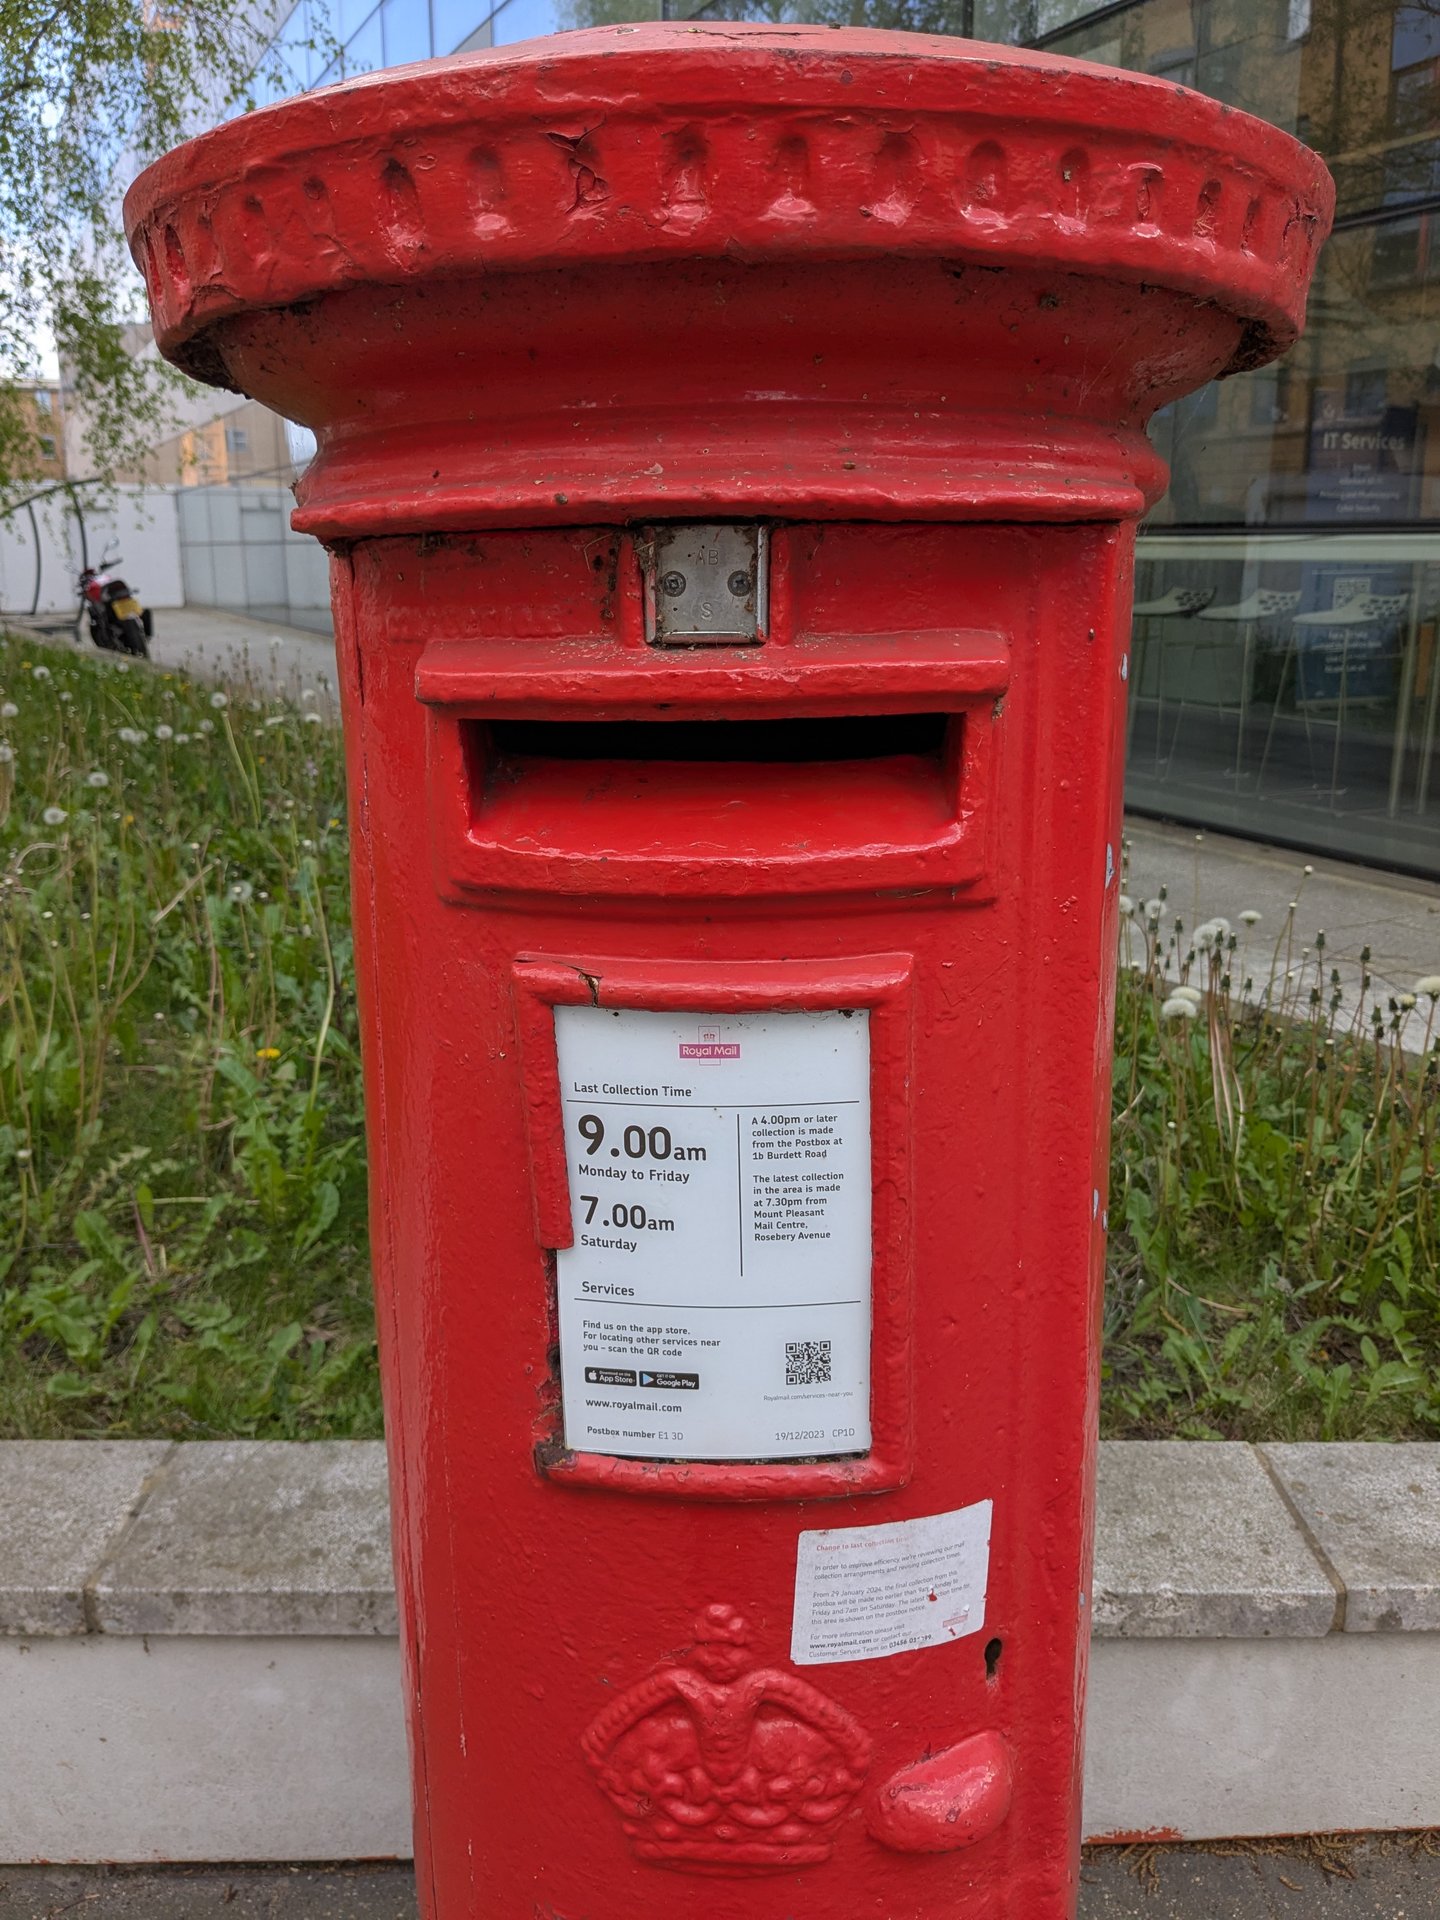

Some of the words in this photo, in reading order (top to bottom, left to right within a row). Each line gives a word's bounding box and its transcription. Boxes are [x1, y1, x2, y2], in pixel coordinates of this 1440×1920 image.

[1324, 432, 1338, 449] IT
[1342, 432, 1404, 449] Services
[682, 1046, 712, 1057] Royal
[715, 1045, 737, 1055] Mail
[574, 1082, 599, 1093] Last
[603, 1084, 658, 1096] Collection
[662, 1086, 692, 1097] Time
[761, 1115, 800, 1125] 4.00pm
[817, 1114, 838, 1122] later
[578, 1114, 707, 1160] 9.00am
[753, 1127, 795, 1136] collection
[809, 1126, 833, 1134] made
[753, 1140, 774, 1148] from
[778, 1139, 792, 1147] the
[796, 1138, 830, 1146] Postbox
[753, 1151, 764, 1159] 1b
[768, 1150, 801, 1159] Burdett
[805, 1150, 827, 1158] Road
[579, 1164, 627, 1181] Monday
[632, 1170, 643, 1180] to
[649, 1170, 690, 1184] Friday
[754, 1175, 769, 1183] The
[773, 1174, 799, 1182] latest
[802, 1172, 844, 1181] collection
[754, 1186, 761, 1194] in
[806, 1184, 813, 1192] is
[816, 1183, 841, 1191] made
[754, 1198, 763, 1206] at
[766, 1197, 803, 1207] 7.30pm
[806, 1197, 827, 1205] from
[580, 1195, 675, 1231] 7.00am
[754, 1210, 783, 1218] Mount
[786, 1208, 824, 1217] Pleasant
[754, 1221, 773, 1230] Mail
[777, 1220, 808, 1230] Centre,
[755, 1233, 796, 1242] Rosebery
[798, 1231, 831, 1239] Avenue
[581, 1235, 637, 1252] Saturday
[582, 1282, 635, 1296] Services
[583, 1320, 601, 1330] Find
[616, 1323, 627, 1331] on
[630, 1323, 644, 1332] the
[647, 1326, 663, 1335] app
[666, 1326, 690, 1335] store.
[584, 1332, 597, 1341] For
[599, 1334, 633, 1344] locating
[636, 1336, 659, 1345] other
[662, 1337, 697, 1346] services
[608, 1345, 627, 1353] scan
[630, 1346, 644, 1354] the
[647, 1347, 660, 1355] QR
[663, 1348, 682, 1357] code
[682, 1379, 695, 1388] Play
[586, 1399, 682, 1413] www.royalmail.com
[588, 1426, 619, 1436] Postbox
[623, 1429, 655, 1438] number
[658, 1431, 668, 1440] E1
[672, 1431, 683, 1440] 3D
[776, 1430, 825, 1441] 19/12/2023
[832, 1427, 855, 1437] CP1D
[840, 1629, 873, 1637] information
[810, 1638, 872, 1649] www.royalmail.com
